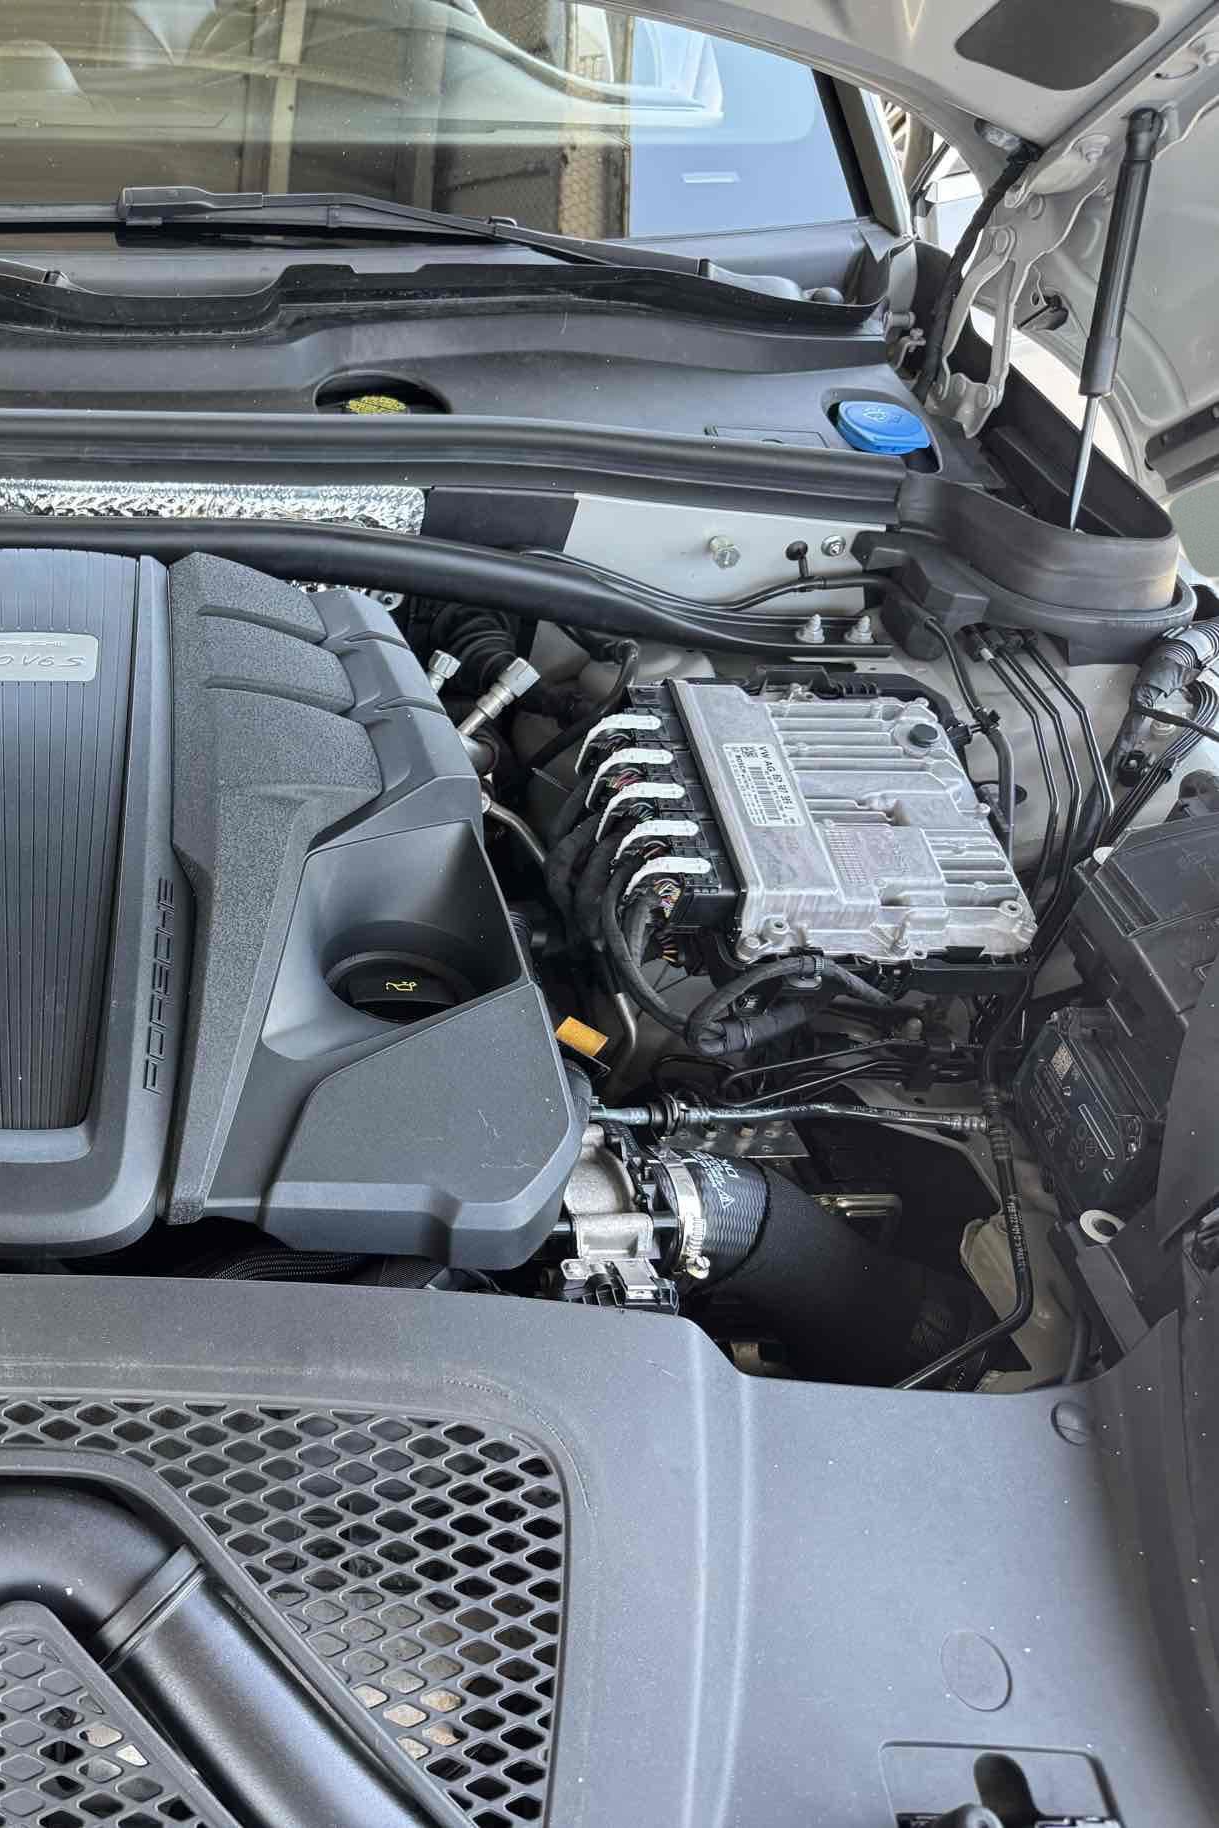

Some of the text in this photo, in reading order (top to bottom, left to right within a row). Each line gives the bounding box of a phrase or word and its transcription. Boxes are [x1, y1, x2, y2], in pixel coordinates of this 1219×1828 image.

[21, 655, 56, 668] V6
[58, 656, 86, 668] S
[759, 746, 771, 759] VW
[765, 761, 776, 772] AG
[143, 877, 175, 1096] PORSCHE
